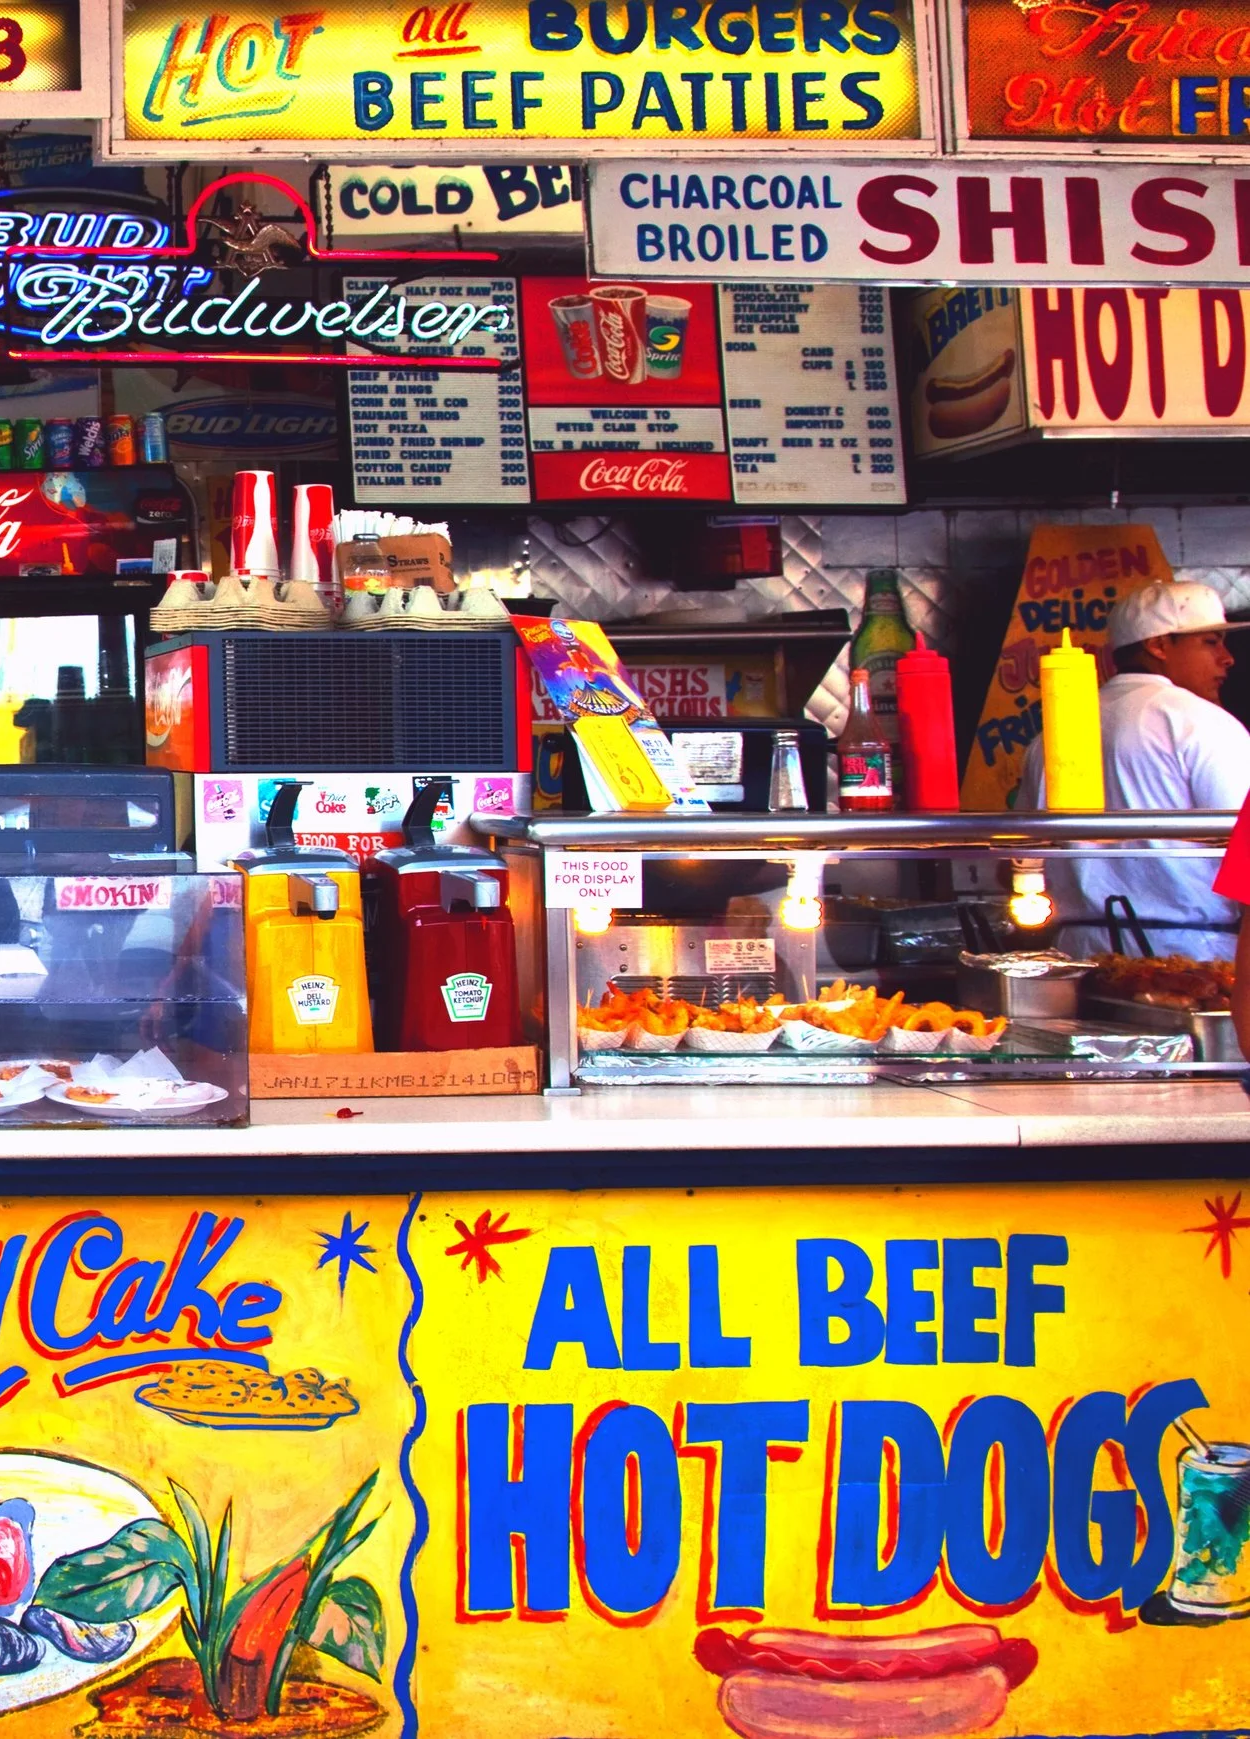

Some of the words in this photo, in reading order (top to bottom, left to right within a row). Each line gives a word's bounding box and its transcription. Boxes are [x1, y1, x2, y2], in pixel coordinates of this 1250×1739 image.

[528, 0, 901, 56] BURGERS
[143, 11, 326, 121] HOT
[354, 69, 546, 131] BEEF
[581, 71, 884, 131] PATTIES
[1004, 72, 1158, 134] Hot
[620, 173, 842, 210] CHARCOAL
[340, 175, 474, 219] COLD
[637, 223, 828, 262] BROILED
[405, 287, 436, 296] HALF
[439, 287, 463, 296] DOZ
[467, 287, 491, 296] RAW
[733, 294, 800, 303] CHOCOLATE
[17, 262, 511, 346] Budweiser
[733, 304, 810, 313] STRAWBERRY
[859, 304, 884, 313] 700
[733, 314, 797, 324] PINEAPPLE
[859, 314, 883, 324] 700
[734, 325, 754, 334] ICE
[760, 325, 800, 334] CREAM
[462, 346, 485, 355] ADD
[725, 342, 757, 352] SODA
[801, 347, 834, 357] CANS
[1031, 288, 1171, 421] HOT
[801, 361, 833, 370] CUPS
[350, 371, 380, 381] BEEF
[389, 371, 439, 381] PATTIES
[351, 385, 388, 394] ONION
[395, 385, 433, 394] RINGS
[498, 385, 522, 395] 300
[352, 398, 384, 407] CORN
[390, 398, 406, 407] ON
[414, 398, 437, 407] THE
[444, 398, 468, 407] COB
[498, 398, 521, 407] 300
[729, 399, 762, 408] BEER
[353, 411, 408, 420] SAUSAGE
[420, 411, 460, 420] HEROS
[499, 411, 522, 421] 700
[590, 410, 648, 420] WELCOME
[654, 410, 671, 420] TO
[866, 406, 889, 416] 400
[166, 413, 246, 434] BUD
[556, 423, 594, 432] PETES
[603, 423, 636, 432] CLAM
[647, 423, 679, 432] STOP
[785, 420, 844, 429] IMPORTED
[354, 424, 378, 434] HOT
[389, 424, 428, 434] PIZZA
[500, 424, 523, 434] 250
[354, 437, 394, 446] JUMBO
[400, 437, 435, 446] FRIED
[440, 437, 485, 447] SHRIMP
[533, 441, 555, 450] TAX
[732, 437, 769, 447] DRAFT
[782, 437, 813, 447] BEER
[819, 437, 834, 447] 32
[841, 437, 858, 447] OZ
[355, 450, 391, 460] FRIED
[400, 450, 452, 460] CHICKEN
[733, 453, 776, 463] COFFEE
[871, 453, 893, 463] 100
[355, 463, 403, 473] COTTON
[410, 463, 452, 473] CANDY
[502, 463, 525, 473] 300
[734, 463, 758, 473] TEA
[871, 463, 894, 473] 200
[579, 457, 690, 493] Coca-Cola
[357, 476, 405, 486] ITALIAN
[412, 476, 442, 486] ICES
[502, 476, 527, 486] 200
[148, 509, 173, 519] zero
[1025, 545, 1151, 599] GOLDEN
[315, 800, 347, 814] Coke
[301, 833, 337, 848] FOOD
[347, 835, 389, 850] FOR
[562, 861, 589, 871] THIS
[593, 861, 629, 871] FOOD
[555, 875, 580, 884] FOR
[584, 875, 636, 884] DISPLAY
[579, 888, 611, 898] ONLY
[301, 981, 326, 991] HEINZ
[455, 979, 480, 988] HEINZ
[454, 989, 483, 997] TOMATO
[297, 999, 331, 1007] MUSTARD
[453, 996, 484, 1004] KETCHUP
[18, 1210, 285, 1360] Cake
[522, 1244, 752, 1371] ALL
[796, 1233, 1070, 1368] BEEF
[456, 1399, 811, 1627] HOT
[815, 1378, 1212, 1633] DOGS
